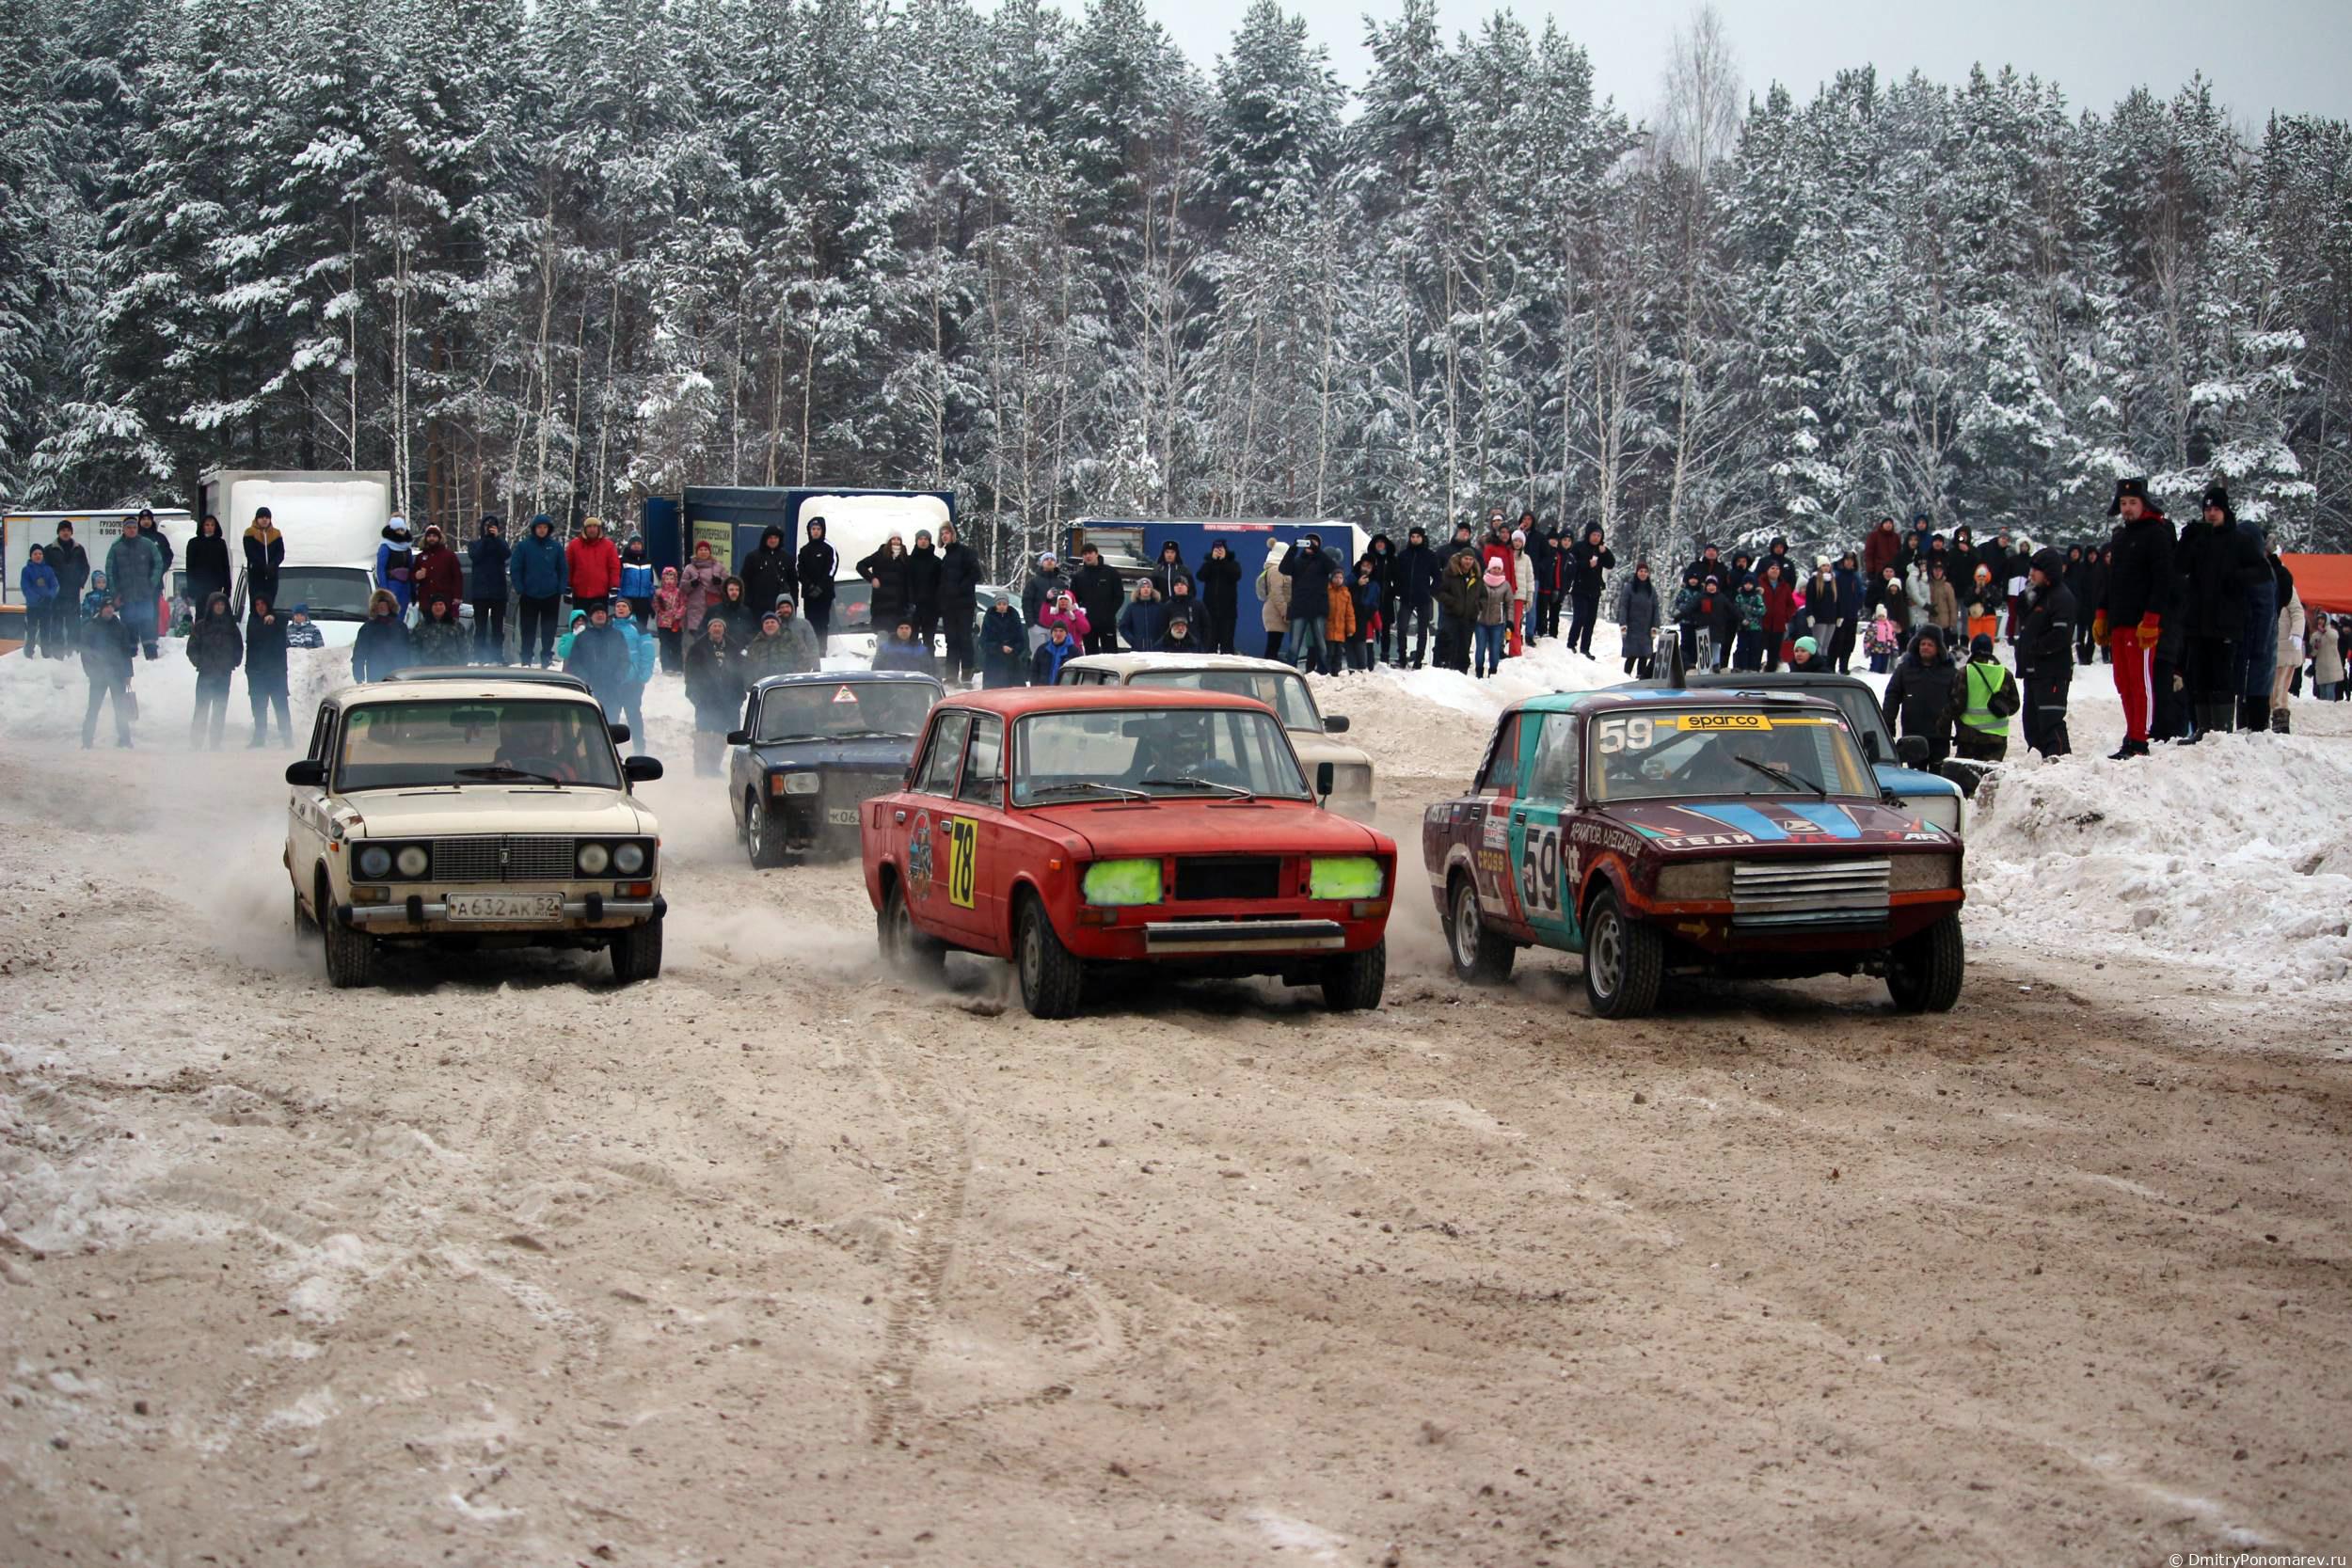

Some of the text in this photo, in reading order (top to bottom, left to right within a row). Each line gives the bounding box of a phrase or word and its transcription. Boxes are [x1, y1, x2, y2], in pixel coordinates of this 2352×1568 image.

[1654, 640, 1673, 679] 59
[1698, 634, 1710, 670] 56
[1688, 716, 1759, 729] sparco
[1599, 718, 1653, 753] 59
[832, 811, 860, 823] К06
[1664, 834, 1754, 847] TEAM
[1904, 832, 1943, 843] AR
[953, 822, 974, 903] 78
[1477, 849, 1504, 873] CROSS
[1523, 828, 1557, 911] 59
[537, 897, 554, 911] 52
